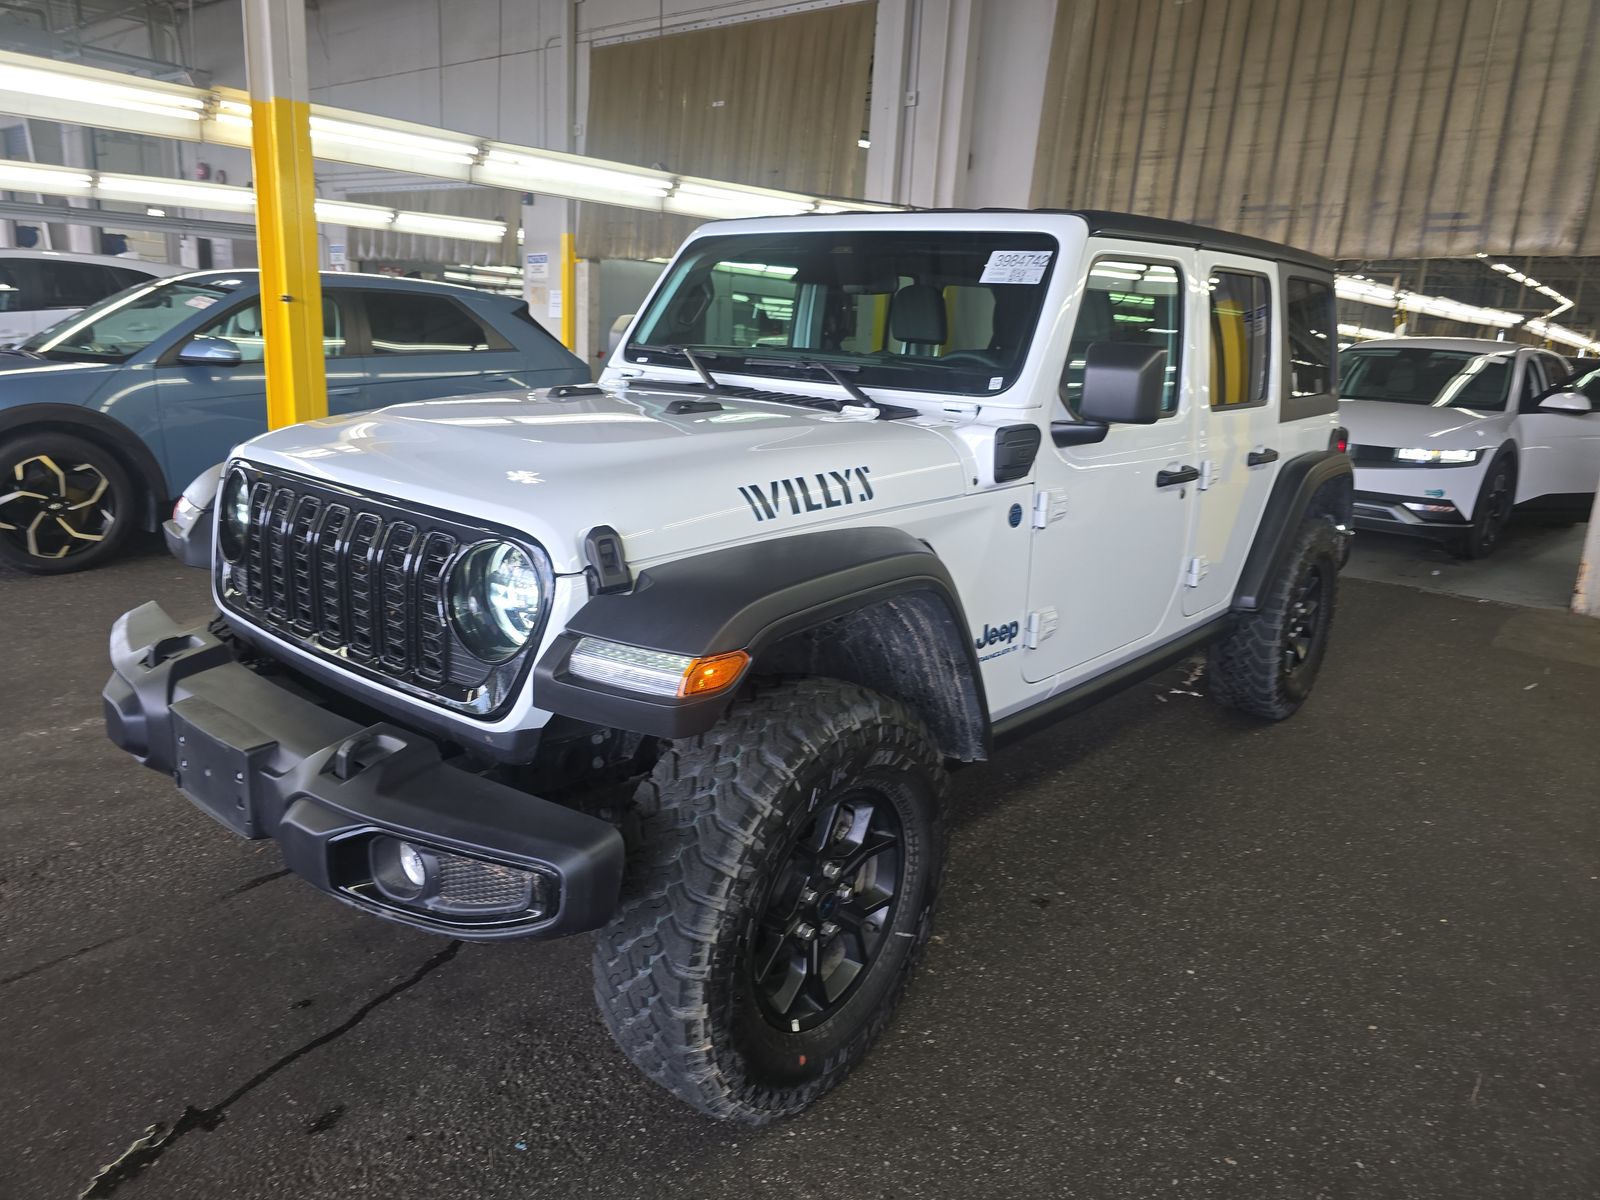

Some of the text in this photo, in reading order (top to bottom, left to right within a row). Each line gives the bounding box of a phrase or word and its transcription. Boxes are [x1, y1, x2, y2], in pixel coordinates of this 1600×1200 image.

[994, 254, 1050, 267] 3984742
[738, 466, 874, 521] WILLYS
[976, 620, 1018, 649] Jeep
